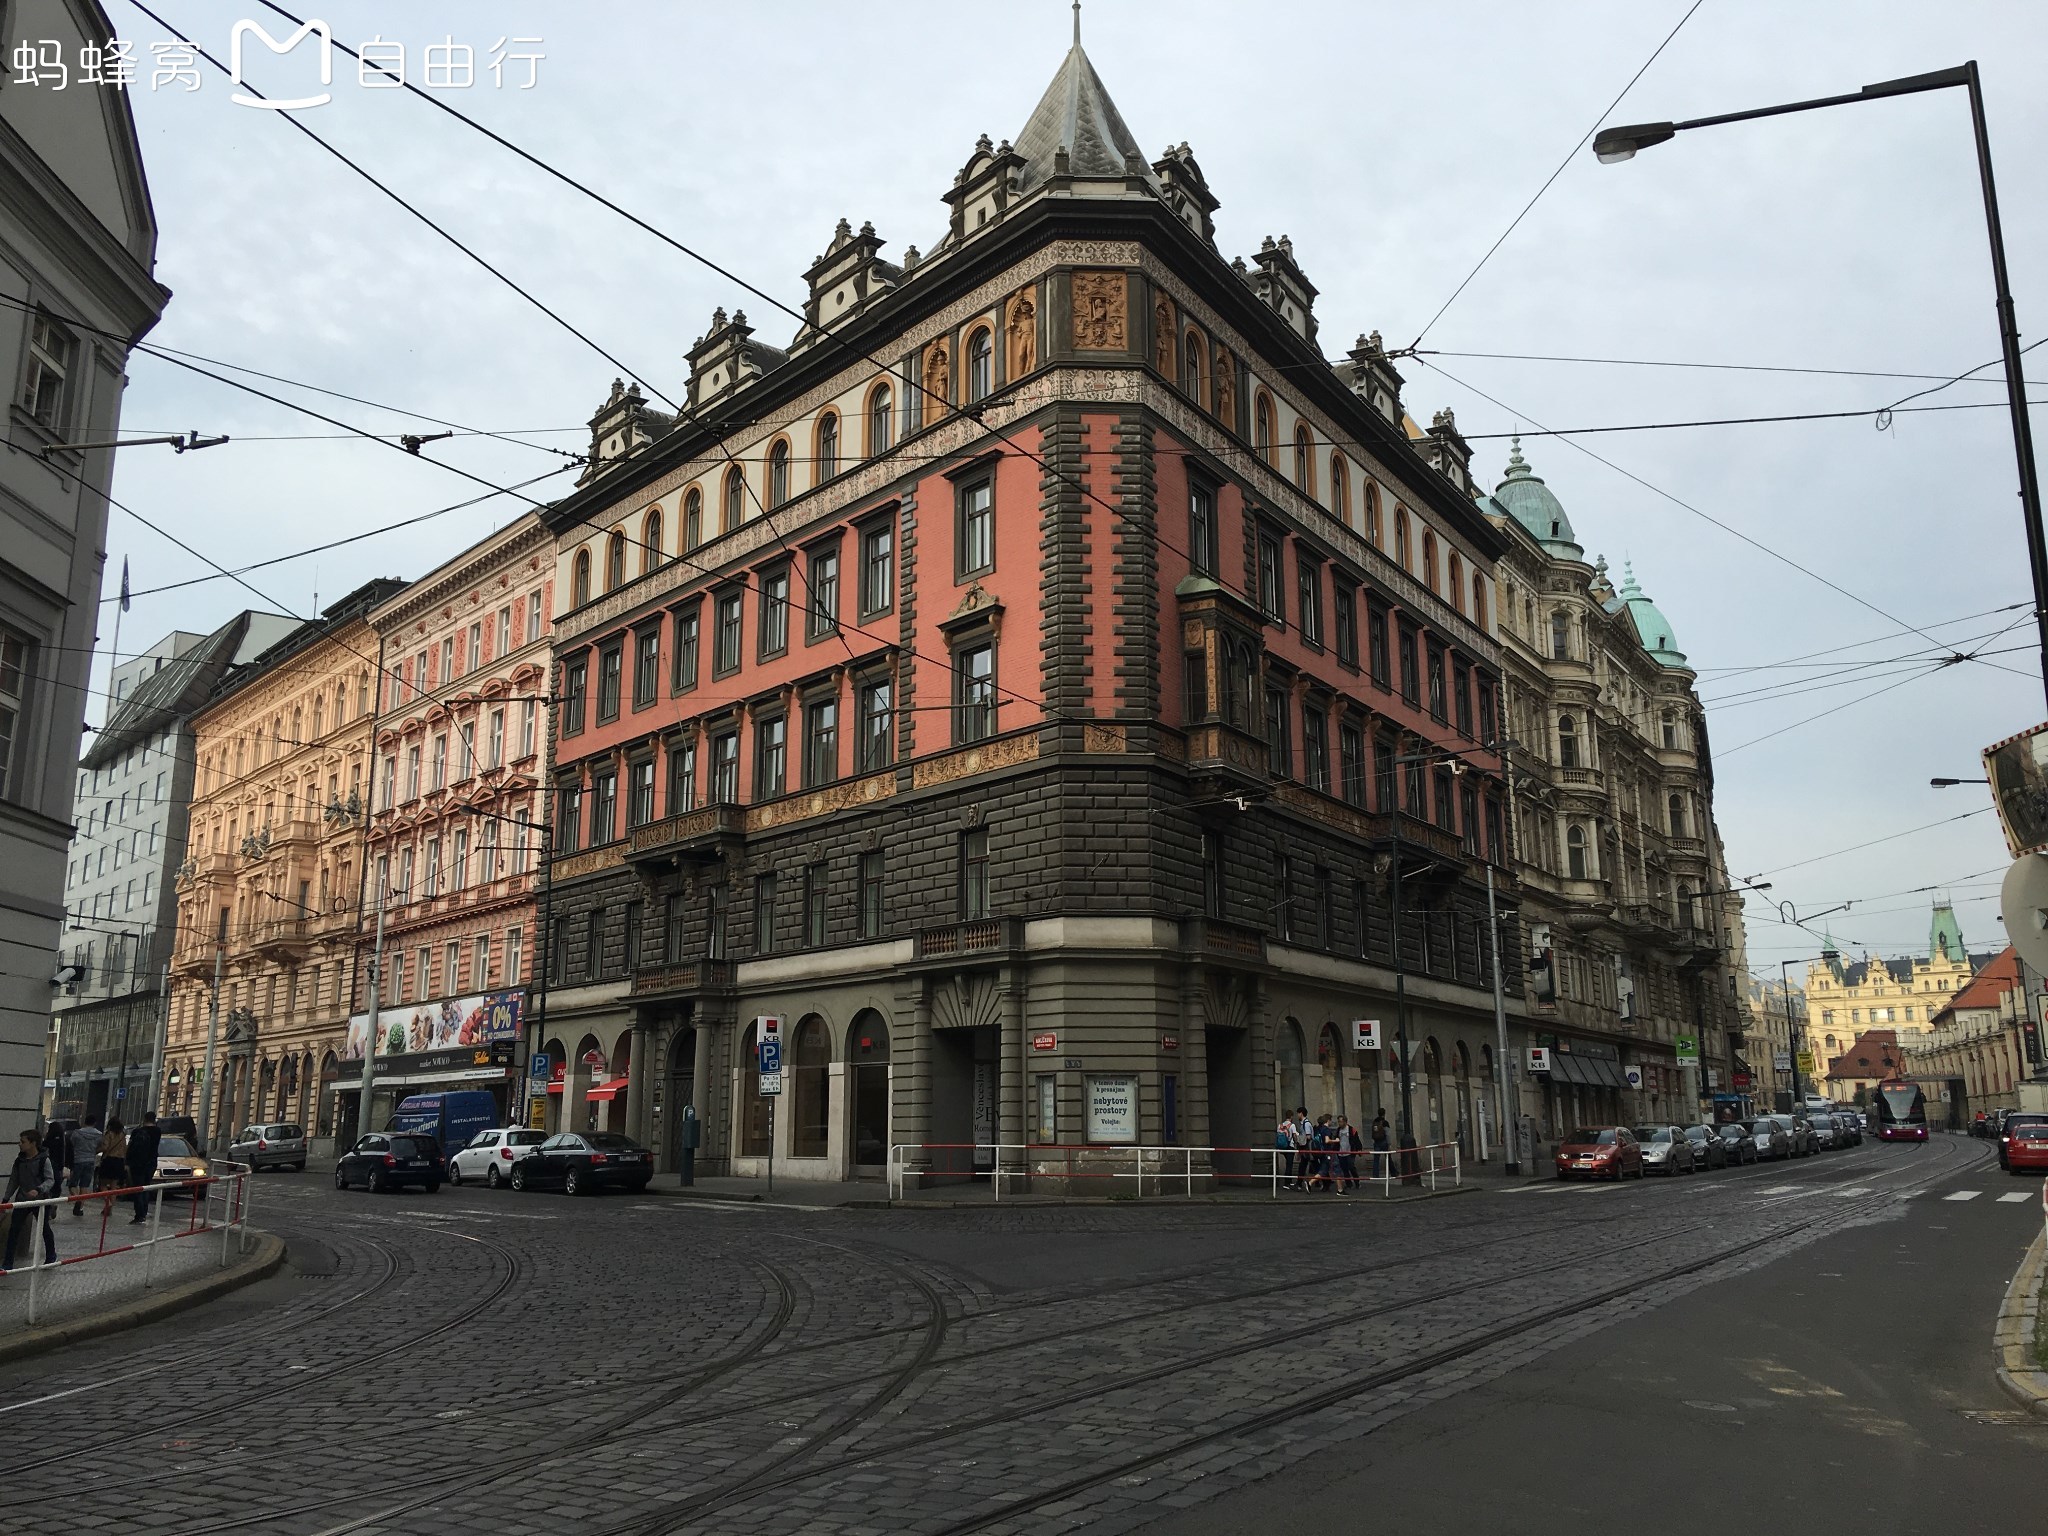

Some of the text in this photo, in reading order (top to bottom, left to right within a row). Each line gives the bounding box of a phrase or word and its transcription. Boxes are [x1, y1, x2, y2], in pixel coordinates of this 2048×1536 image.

[492, 1005, 512, 1030] 0%
[1357, 1039, 1375, 1047] KB
[763, 1045, 776, 1063] P
[535, 1057, 545, 1072] P
[1093, 1096, 1128, 1106] nebytové
[688, 1109, 694, 1117] P
[1094, 1107, 1128, 1116] prostory
